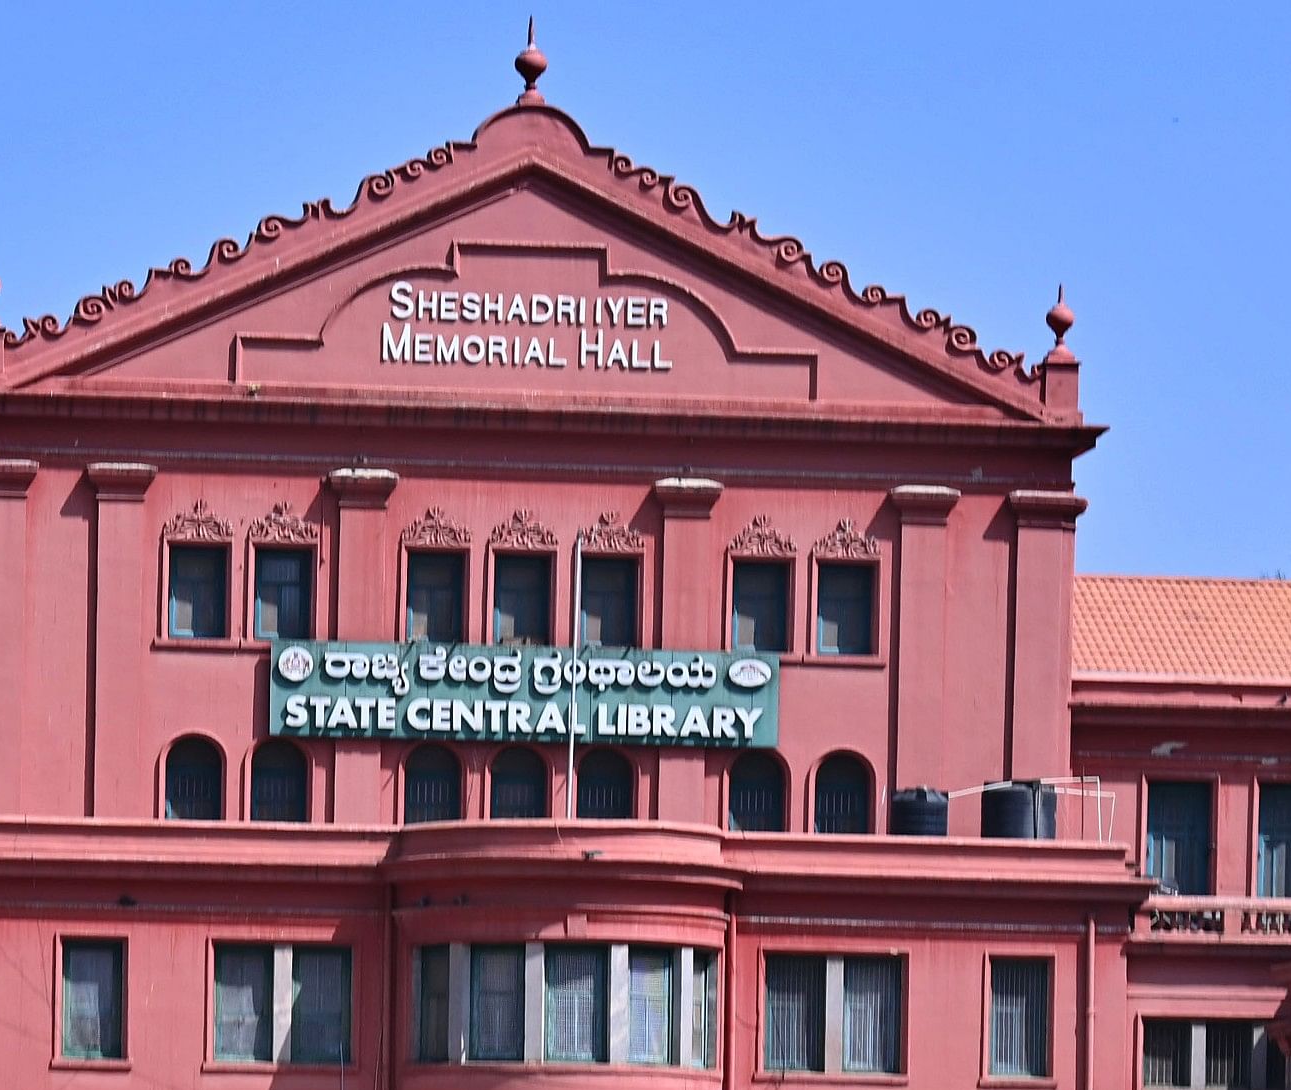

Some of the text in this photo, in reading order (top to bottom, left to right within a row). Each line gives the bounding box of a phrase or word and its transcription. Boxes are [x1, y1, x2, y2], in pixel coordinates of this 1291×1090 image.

[390, 281, 669, 326] SHESHADRI IYER
[381, 322, 673, 369] MEMORIAL HALL
[324, 645, 717, 695] ರಾಜ್ಯ ಕೇಂದ್ರ ಗ್ರಂಥಾಲಯ
[285, 696, 763, 739] STATE CENTRAL LIBRARY
